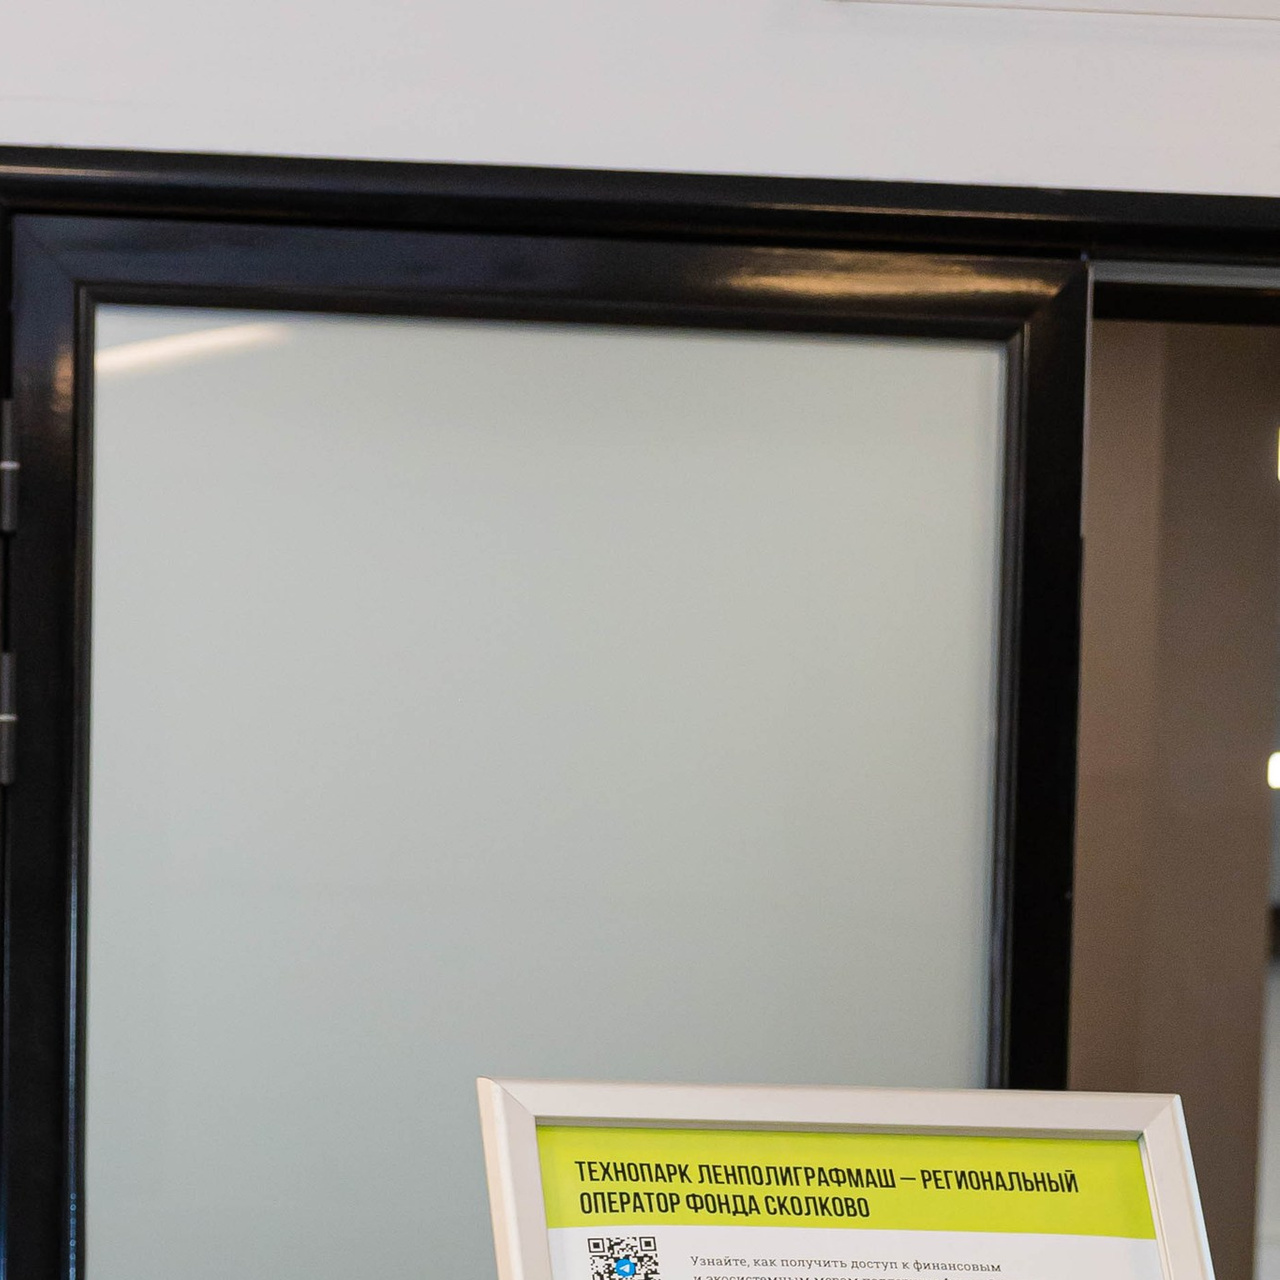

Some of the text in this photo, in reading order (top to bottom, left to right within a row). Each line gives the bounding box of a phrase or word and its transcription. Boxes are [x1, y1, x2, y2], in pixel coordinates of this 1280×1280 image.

[575, 1161, 692, 1183] ТЕХНОПАРК
[698, 1164, 896, 1188] ЛЕНПОЛИГРАФМАШ
[920, 1169, 1079, 1193] РЕГИОНАЛЬНЫЙ
[580, 1192, 870, 1218] ОПЕРАТОР ФОНДА СКОЛКОВО
[690, 1256, 750, 1268] Узнайте,
[753, 1258, 776, 1267] как
[781, 1259, 847, 1269] получить
[851, 1260, 897, 1271] доступ
[913, 1260, 1001, 1272] финансовым
